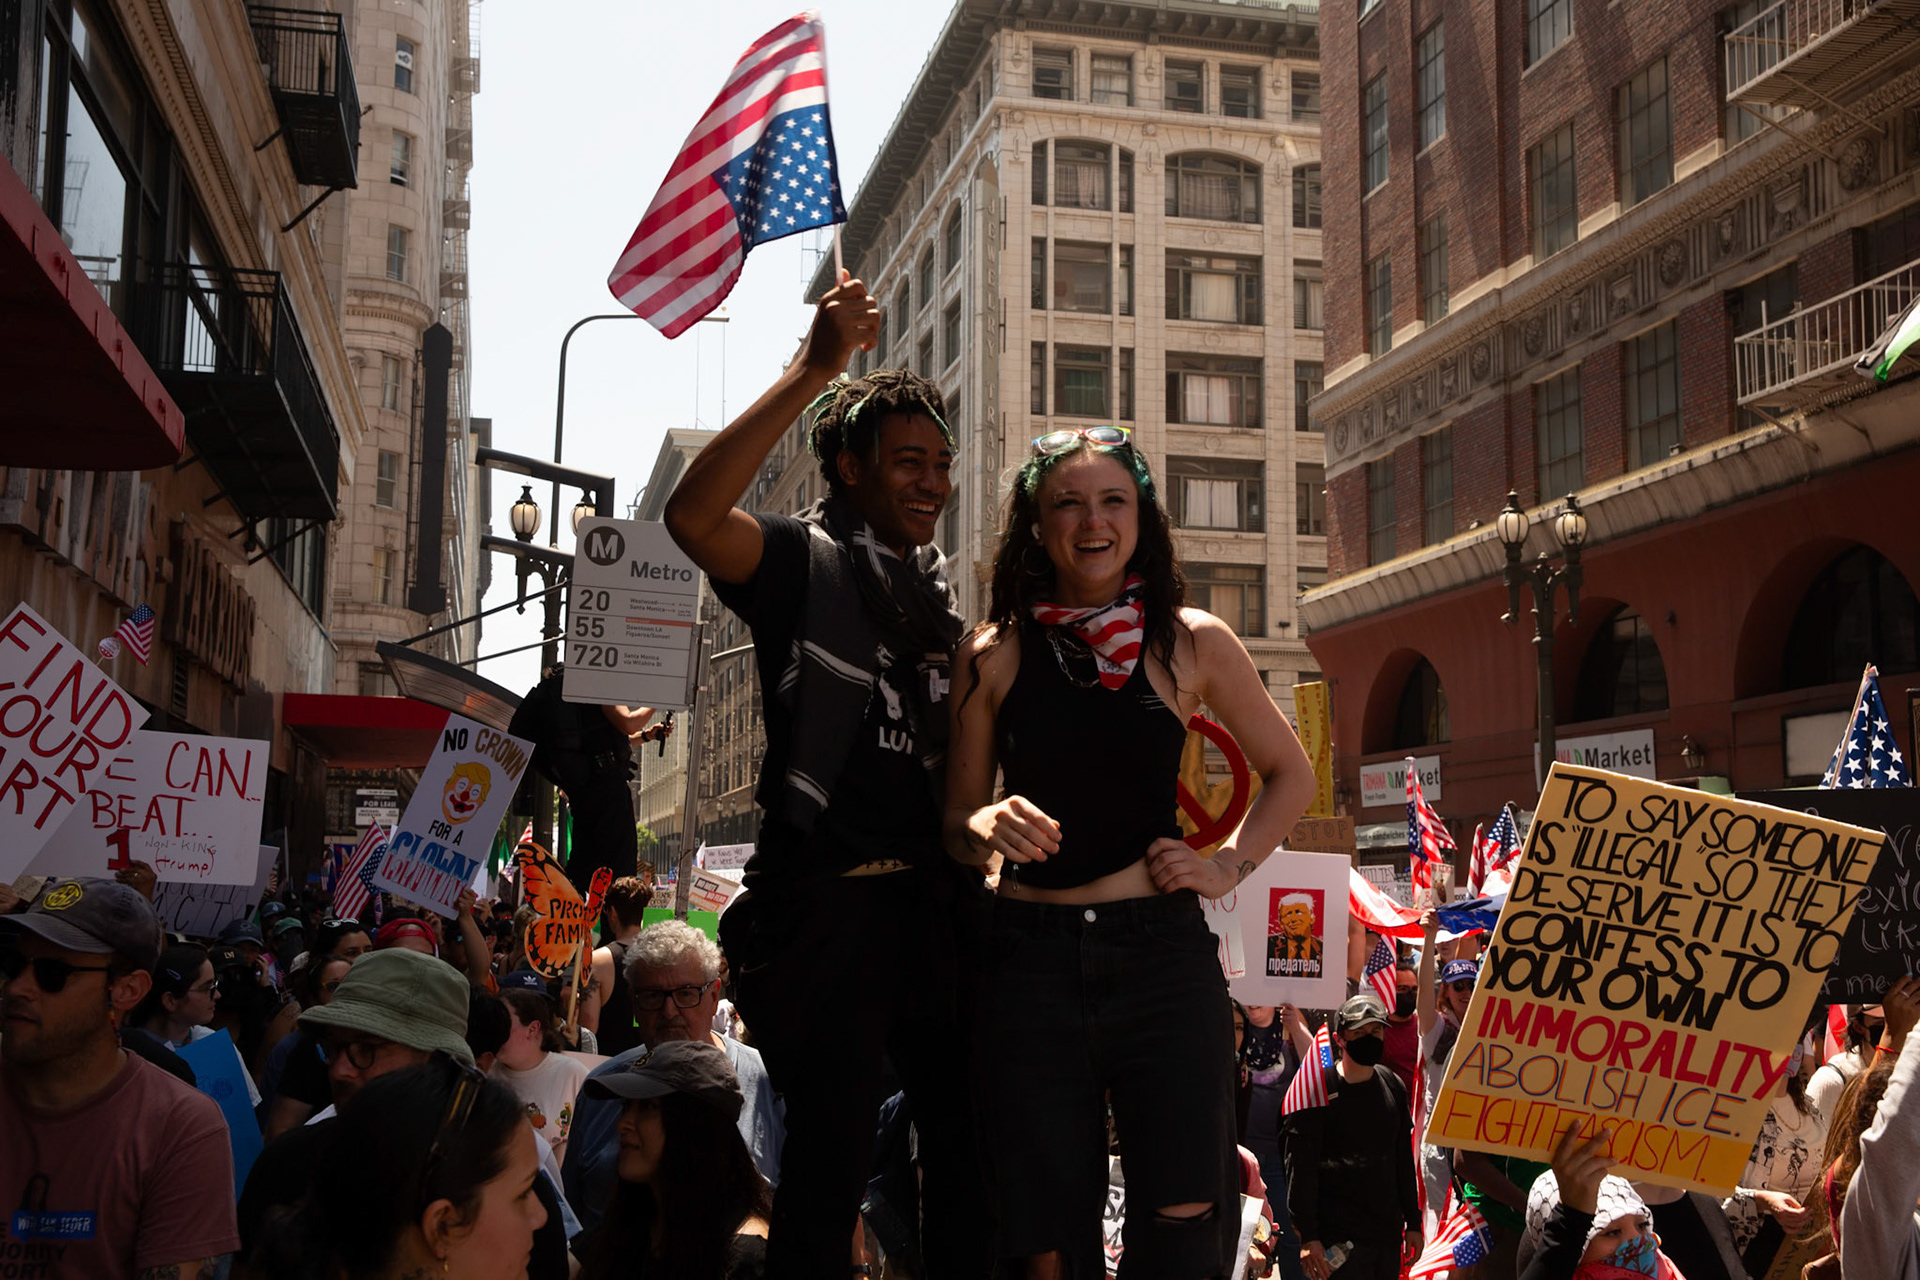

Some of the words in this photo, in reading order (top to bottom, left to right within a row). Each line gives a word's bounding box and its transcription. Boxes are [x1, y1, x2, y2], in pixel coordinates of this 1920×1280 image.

[985, 200, 996, 359] JEWELRY
[985, 381, 996, 526] TRADES
[630, 560, 693, 582] Metro
[579, 589, 611, 612] 20
[575, 616, 605, 638] 55
[626, 624, 655, 632] Downtown
[573, 644, 619, 667] 720
[640, 653, 660, 661] Monica
[0, 610, 132, 750] FIND
[443, 728, 469, 752] NO
[1585, 743, 1651, 769] Market
[1395, 767, 1439, 789] Mket
[428, 820, 452, 841] FOR
[452, 829, 465, 846] A
[1293, 820, 1348, 842] STOP
[1555, 773, 1618, 824] TO
[1627, 796, 1710, 839] SAY
[1702, 808, 1883, 886] SOMEONE
[1527, 822, 1565, 865] IS
[1769, 866, 1862, 932] THEY
[1510, 867, 1692, 937] DESERVE
[1693, 899, 1743, 943] IT
[1739, 907, 1785, 959] IS
[1792, 920, 1844, 974] TO
[1268, 957, 1321, 974] предатель
[1501, 911, 1712, 988] CONFESS
[1721, 949, 1791, 1010] TO
[1485, 945, 1593, 1005] YOUR
[1599, 966, 1726, 1031] OWN
[1477, 995, 1792, 1101] IMMORALITY
[1453, 1042, 1649, 1118] ABOLISH
[1657, 1081, 1748, 1137] ICE.
[1443, 1090, 1560, 1150] FIGHT
